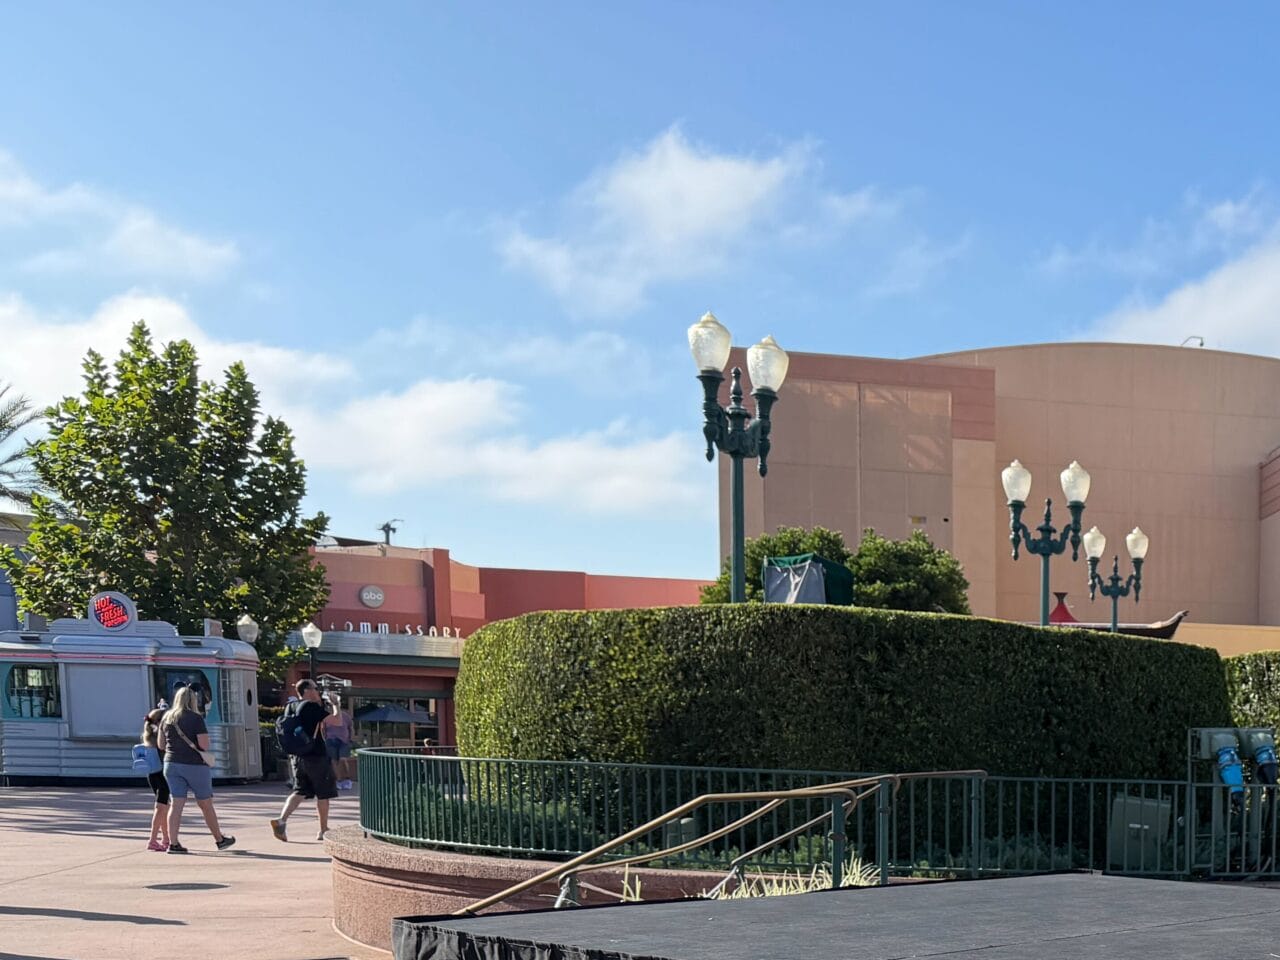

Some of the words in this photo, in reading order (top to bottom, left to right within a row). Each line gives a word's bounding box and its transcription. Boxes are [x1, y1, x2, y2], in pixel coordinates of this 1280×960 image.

[94, 595, 111, 611] HOT
[362, 591, 383, 600] abc
[101, 605, 124, 623] FRESH
[330, 621, 461, 638] OMMISSARY
